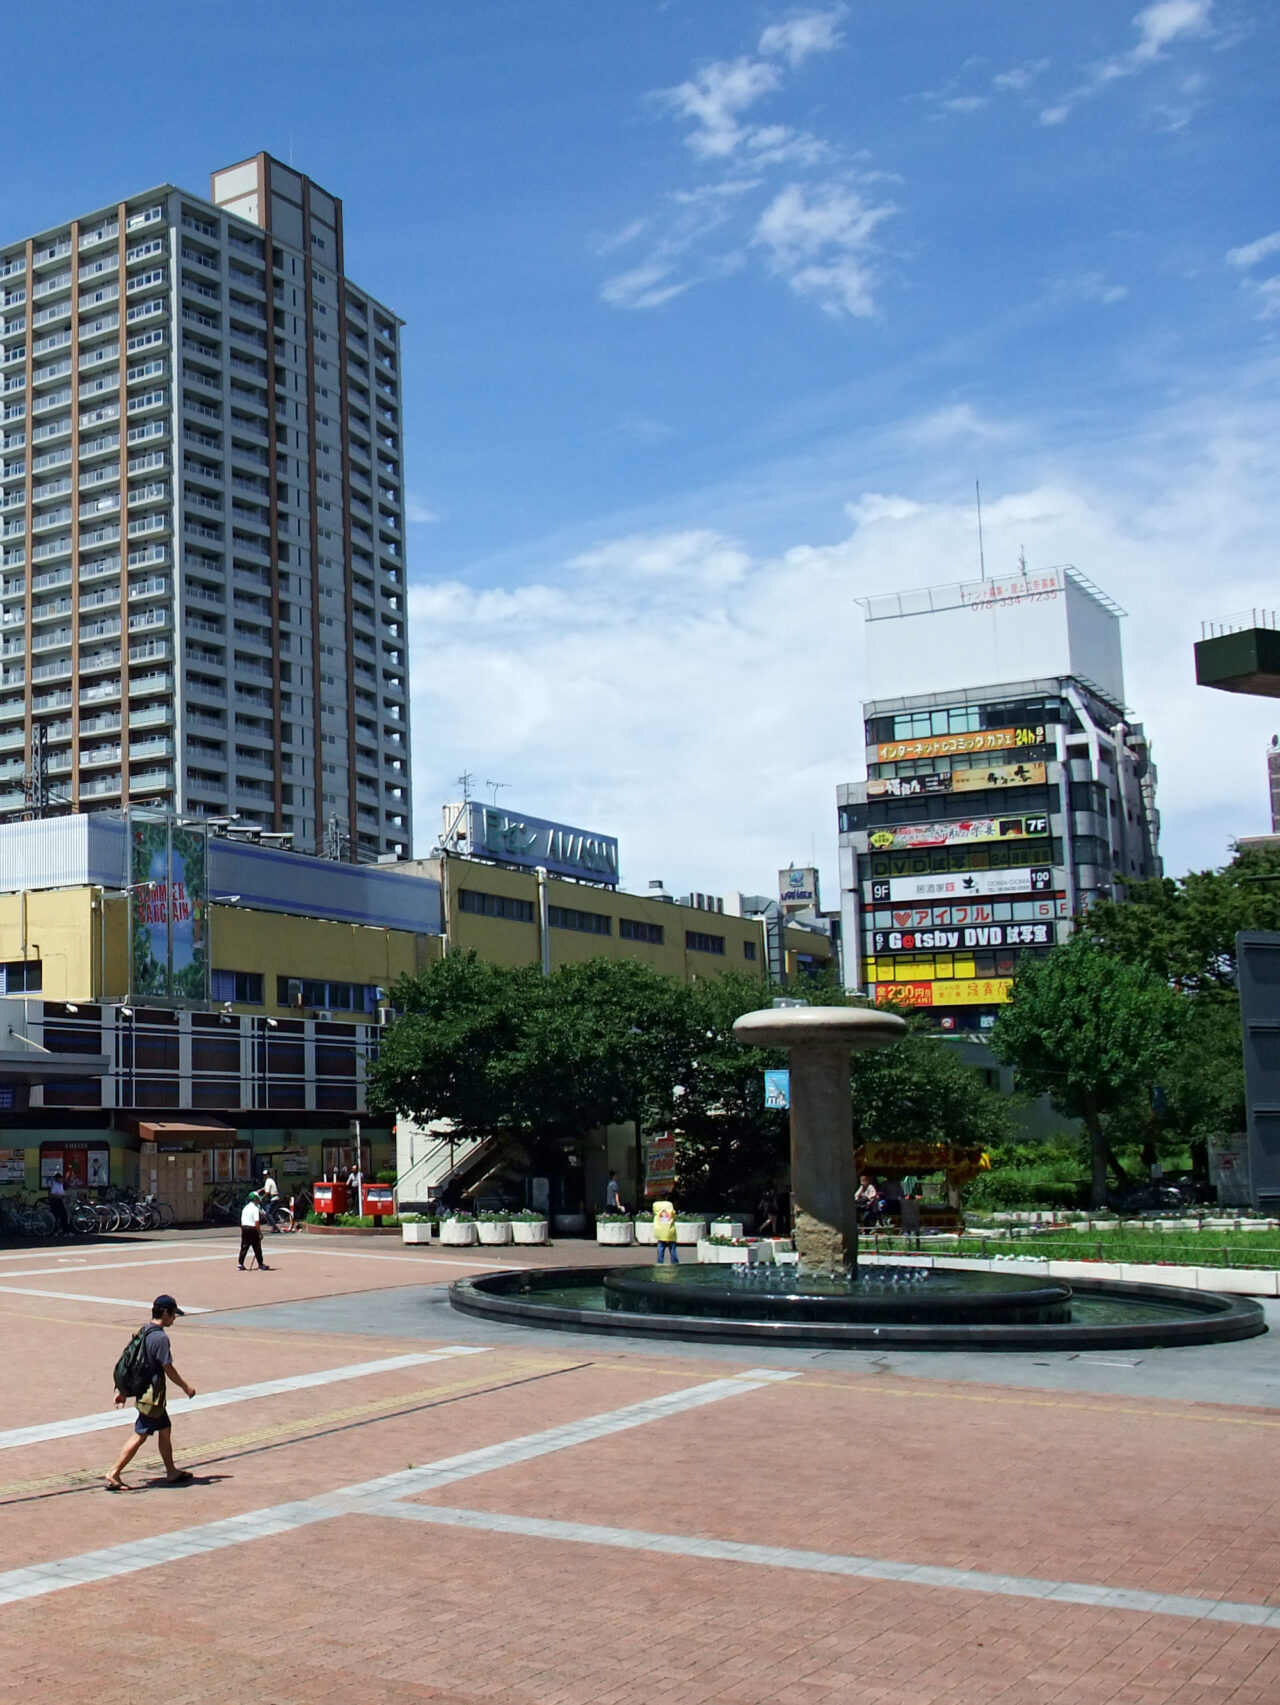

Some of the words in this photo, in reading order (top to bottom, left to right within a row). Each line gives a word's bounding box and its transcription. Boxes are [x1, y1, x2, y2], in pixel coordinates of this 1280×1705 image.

[1016, 728, 1035, 745] 24h
[1026, 819, 1046, 833] 7F
[1032, 872, 1049, 882] 100
[136, 882, 184, 904] SUMMER
[873, 884, 889, 898] 9F
[137, 901, 189, 925] BARGAIN
[915, 907, 990, 925] アイフル
[964, 927, 1002, 946] DVD
[1006, 925, 1048, 944] 試写室
